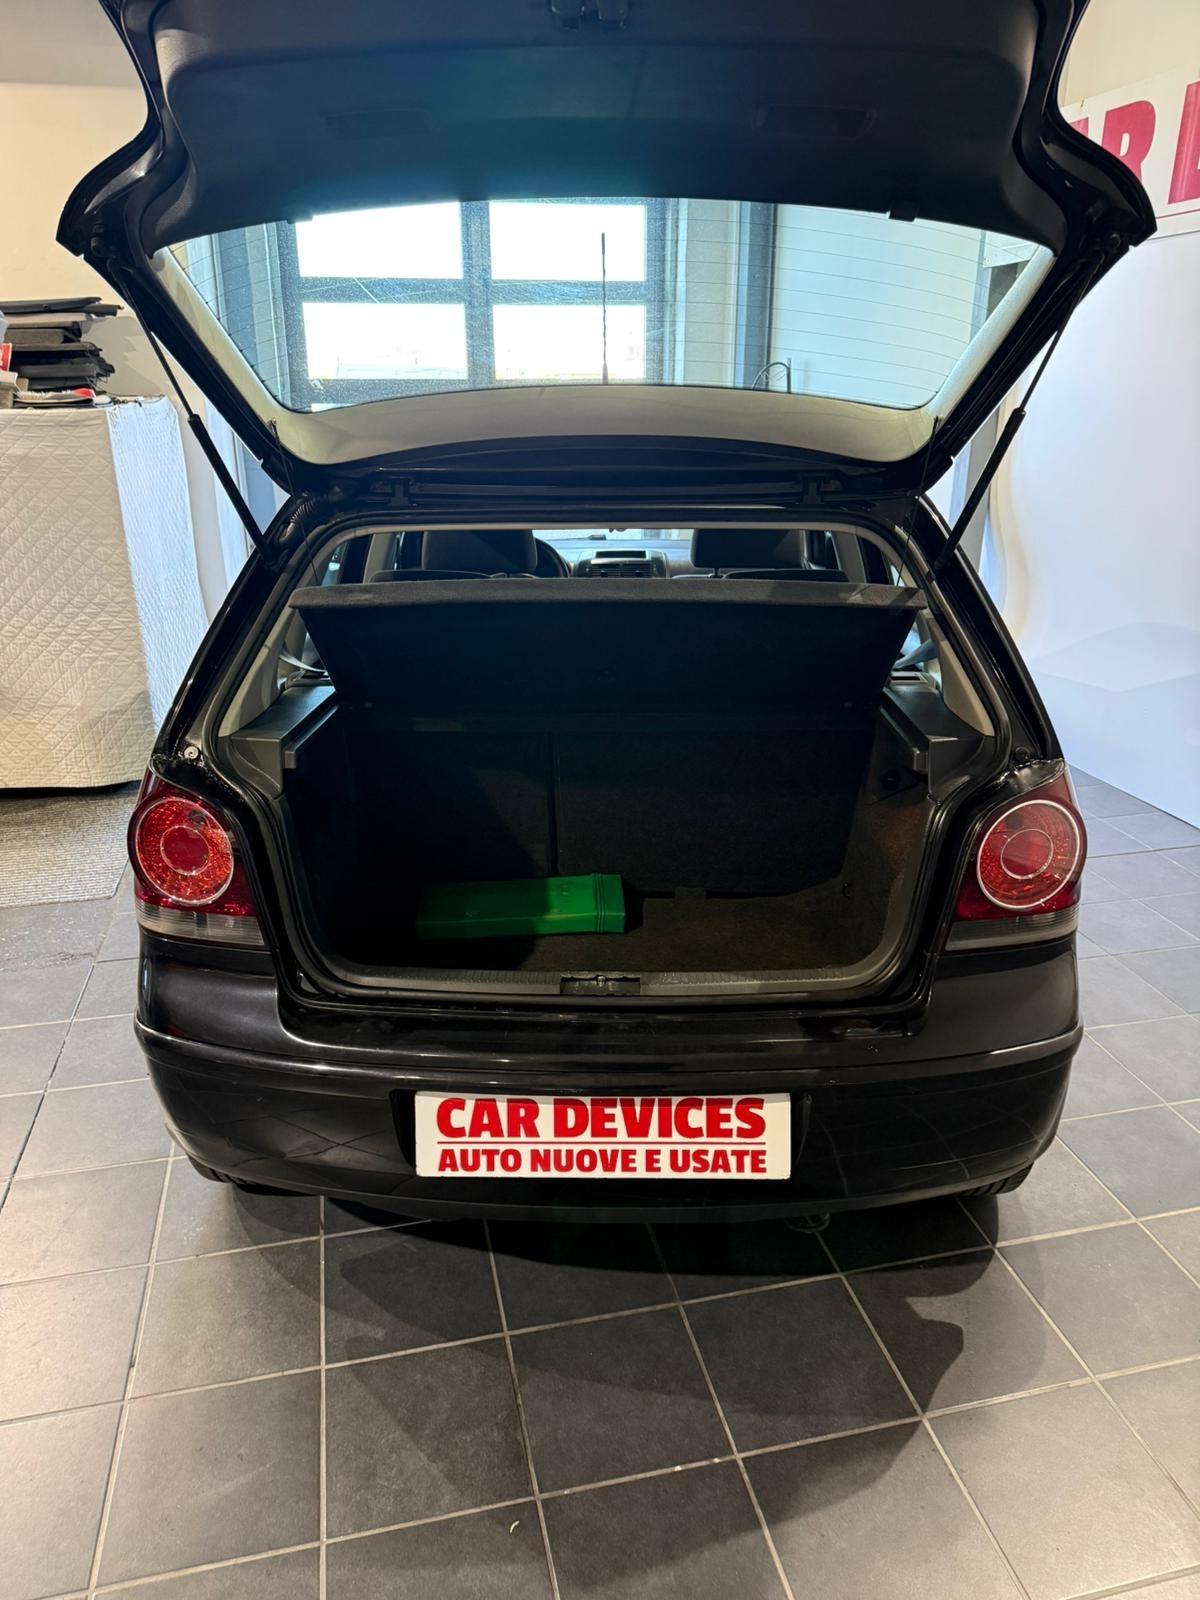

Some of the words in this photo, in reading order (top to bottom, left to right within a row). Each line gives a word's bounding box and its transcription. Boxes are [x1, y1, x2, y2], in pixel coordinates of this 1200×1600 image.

[1070, 100, 1156, 182] R
[436, 1096, 541, 1139] CAR
[552, 1096, 767, 1140] DEVICES
[437, 1147, 523, 1174] AUTO
[530, 1147, 638, 1174] NUOVE
[644, 1148, 662, 1174] E
[669, 1147, 768, 1175] USATE
